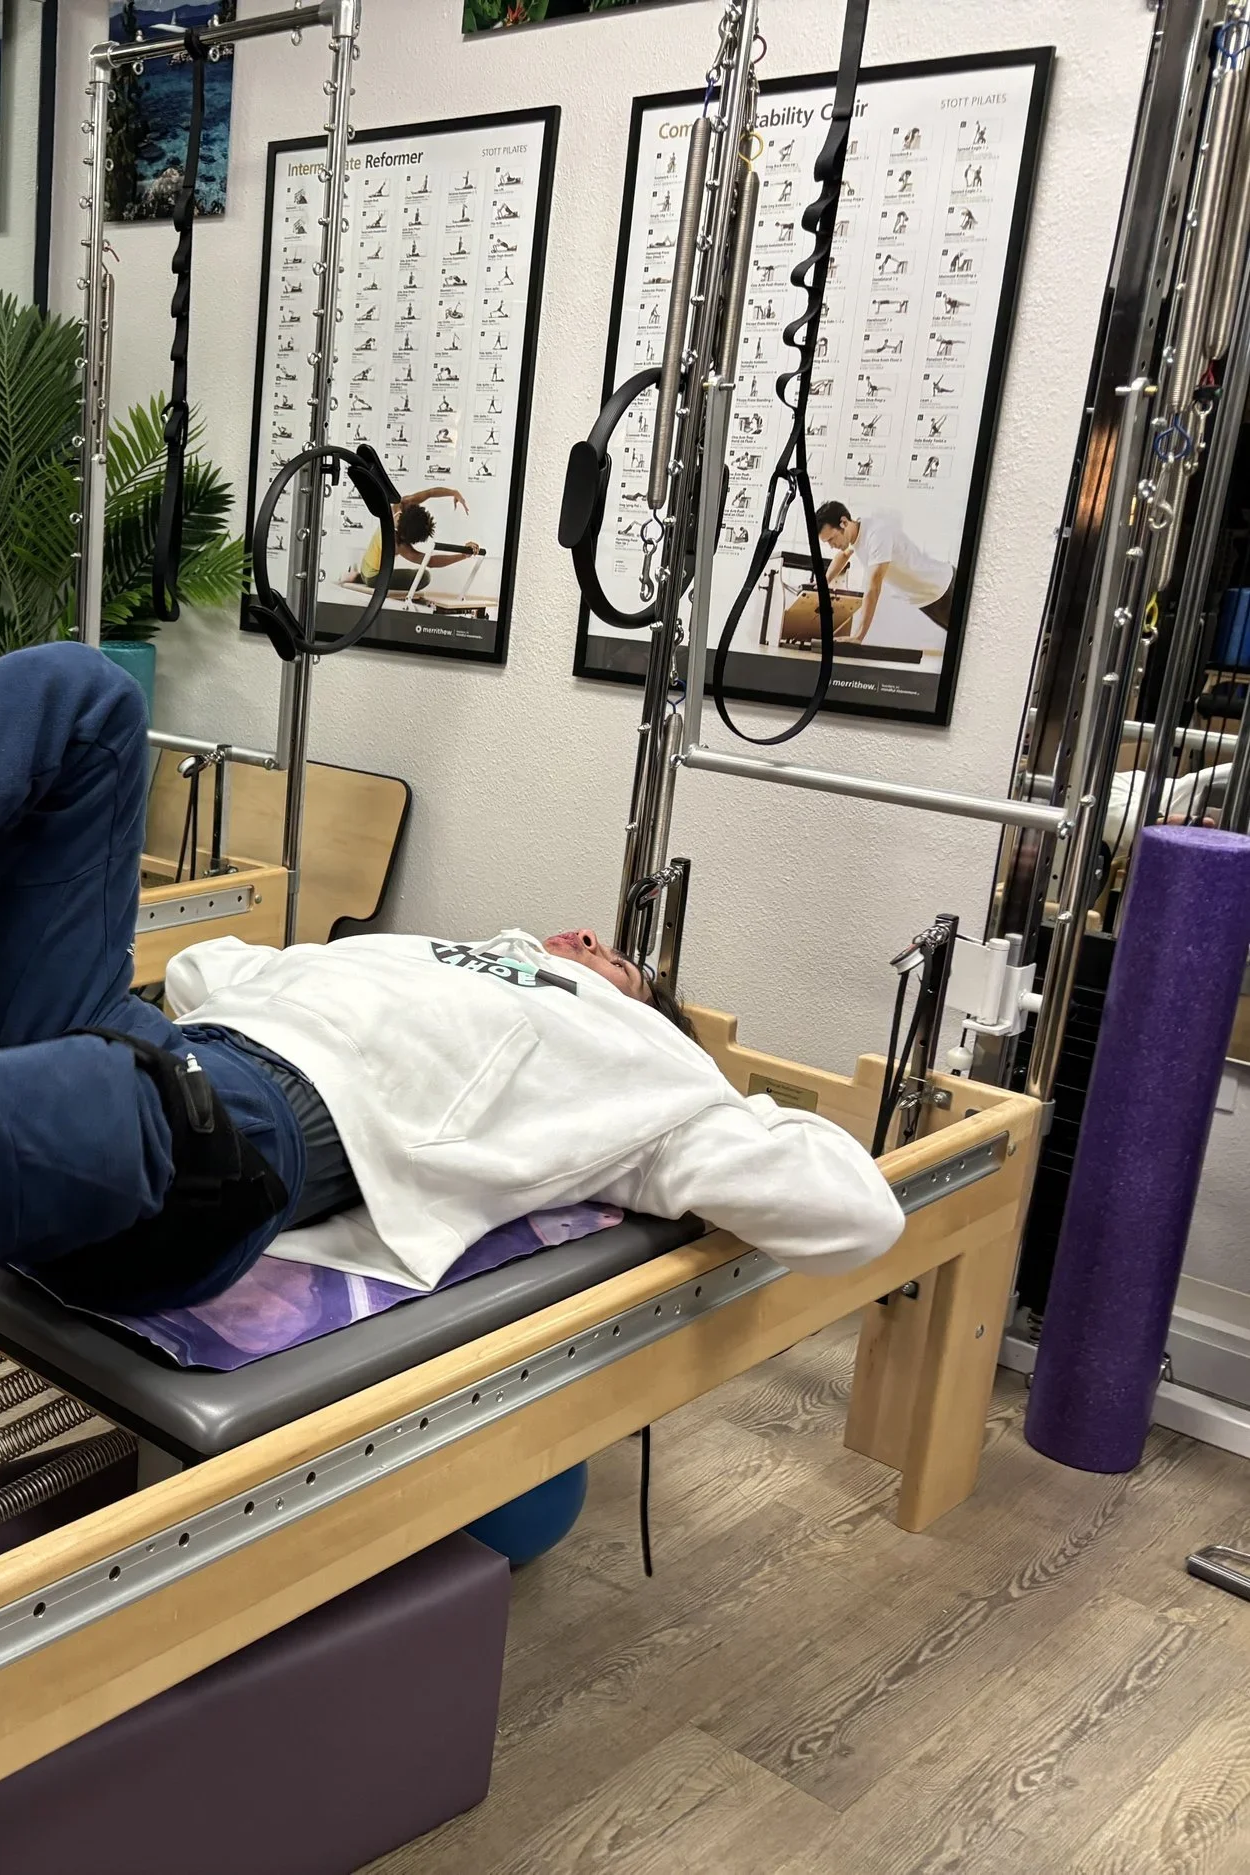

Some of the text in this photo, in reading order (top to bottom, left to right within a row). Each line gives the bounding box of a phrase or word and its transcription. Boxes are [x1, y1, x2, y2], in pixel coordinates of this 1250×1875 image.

[941, 92, 1008, 110] STOTT PILATES
[754, 99, 869, 128] tability Cir
[481, 144, 528, 157] STOTT PILATES
[365, 151, 424, 169] Reformer
[422, 626, 452, 636] merrithew
[832, 679, 877, 691] merrithew
[435, 946, 537, 986] TAHOE
